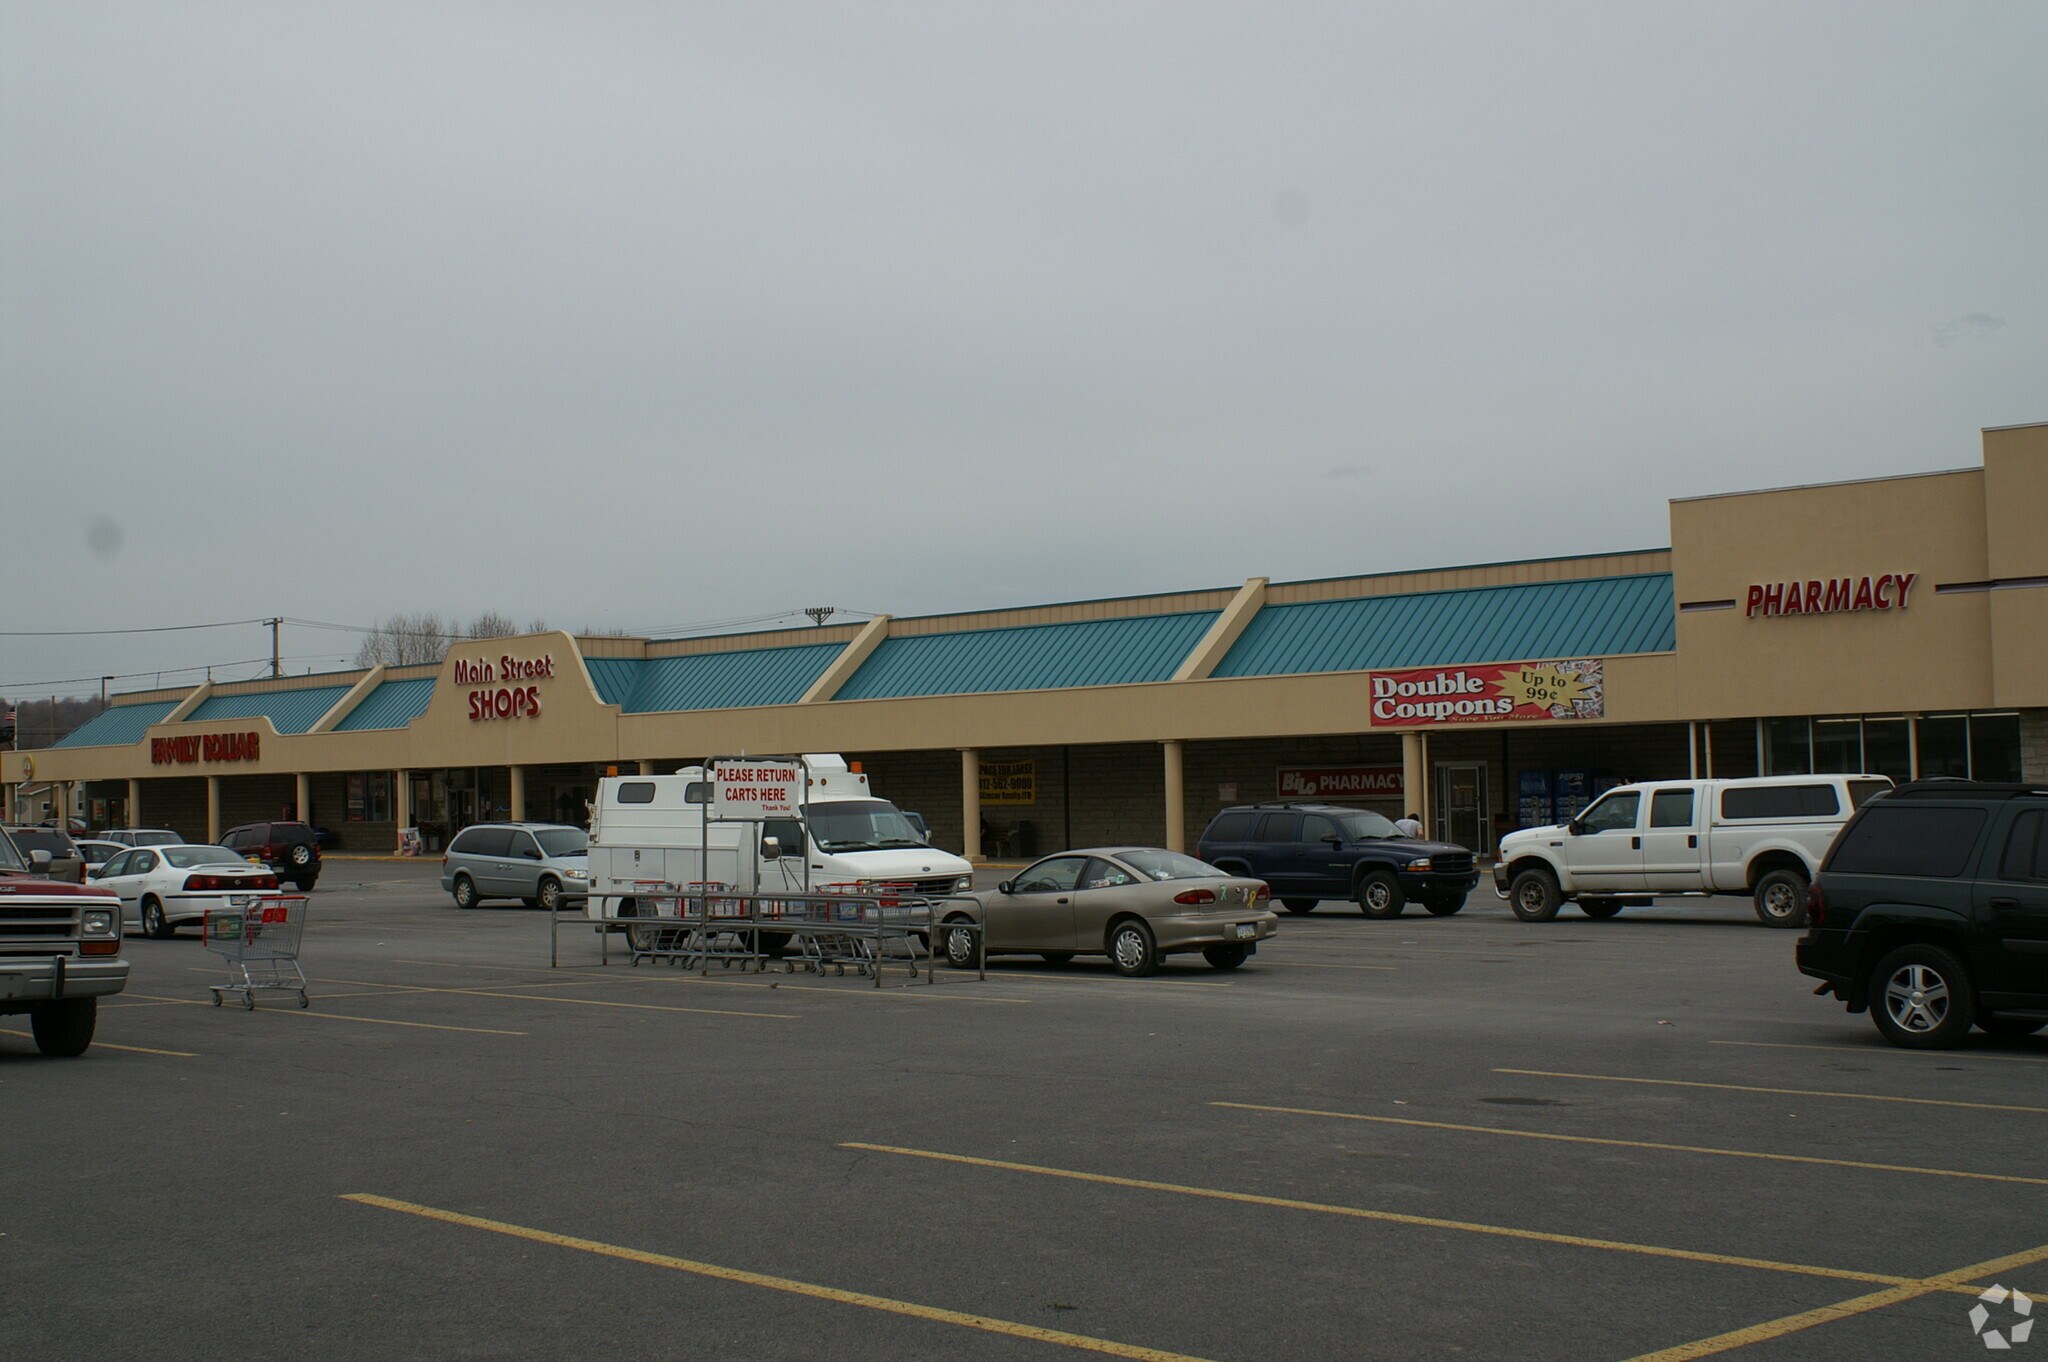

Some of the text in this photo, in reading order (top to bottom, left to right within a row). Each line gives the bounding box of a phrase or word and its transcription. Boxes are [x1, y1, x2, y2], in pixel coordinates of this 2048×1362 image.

[1746, 573, 1917, 617] PHARMACY
[455, 655, 553, 683] Main Street
[1373, 671, 1485, 698] Double
[1522, 671, 1566, 687] Up to
[469, 686, 540, 720] SHOPS
[1526, 688, 1558, 700] 99¢
[1373, 698, 1514, 720] Coupons
[151, 732, 259, 764] FAMILY DOLLAR
[717, 768, 795, 782] PLEASE RETURN
[1320, 774, 1404, 790] PHARMACY
[1559, 773, 1584, 781] PEPSI
[725, 788, 786, 801] CARTS HERE
